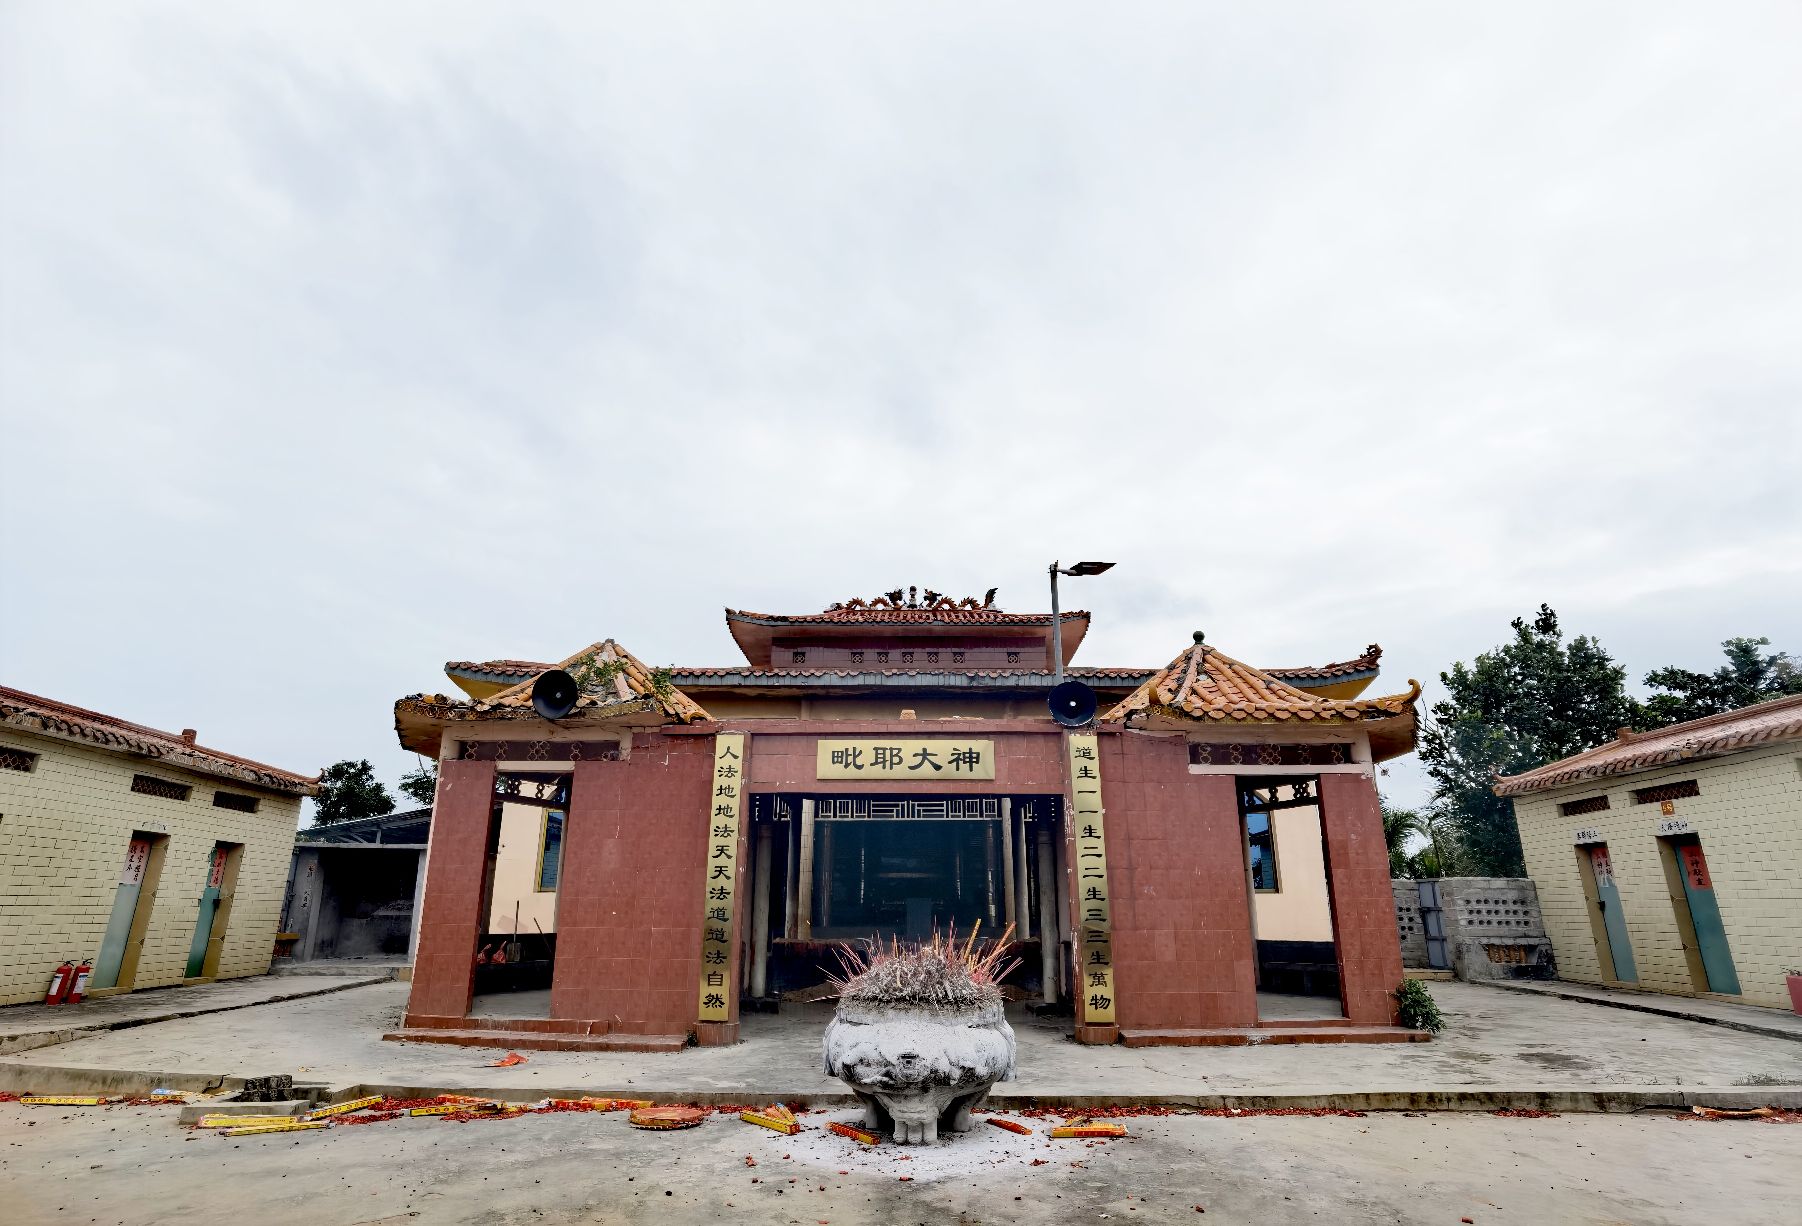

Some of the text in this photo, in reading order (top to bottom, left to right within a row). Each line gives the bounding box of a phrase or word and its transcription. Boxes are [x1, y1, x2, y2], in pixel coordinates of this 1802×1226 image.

[702, 745, 740, 1009] 人法地地法天天法道道法自然
[831, 746, 981, 772] 毗耶大神
[1074, 745, 1111, 1011] 道生一一生二二生三三生萬物
